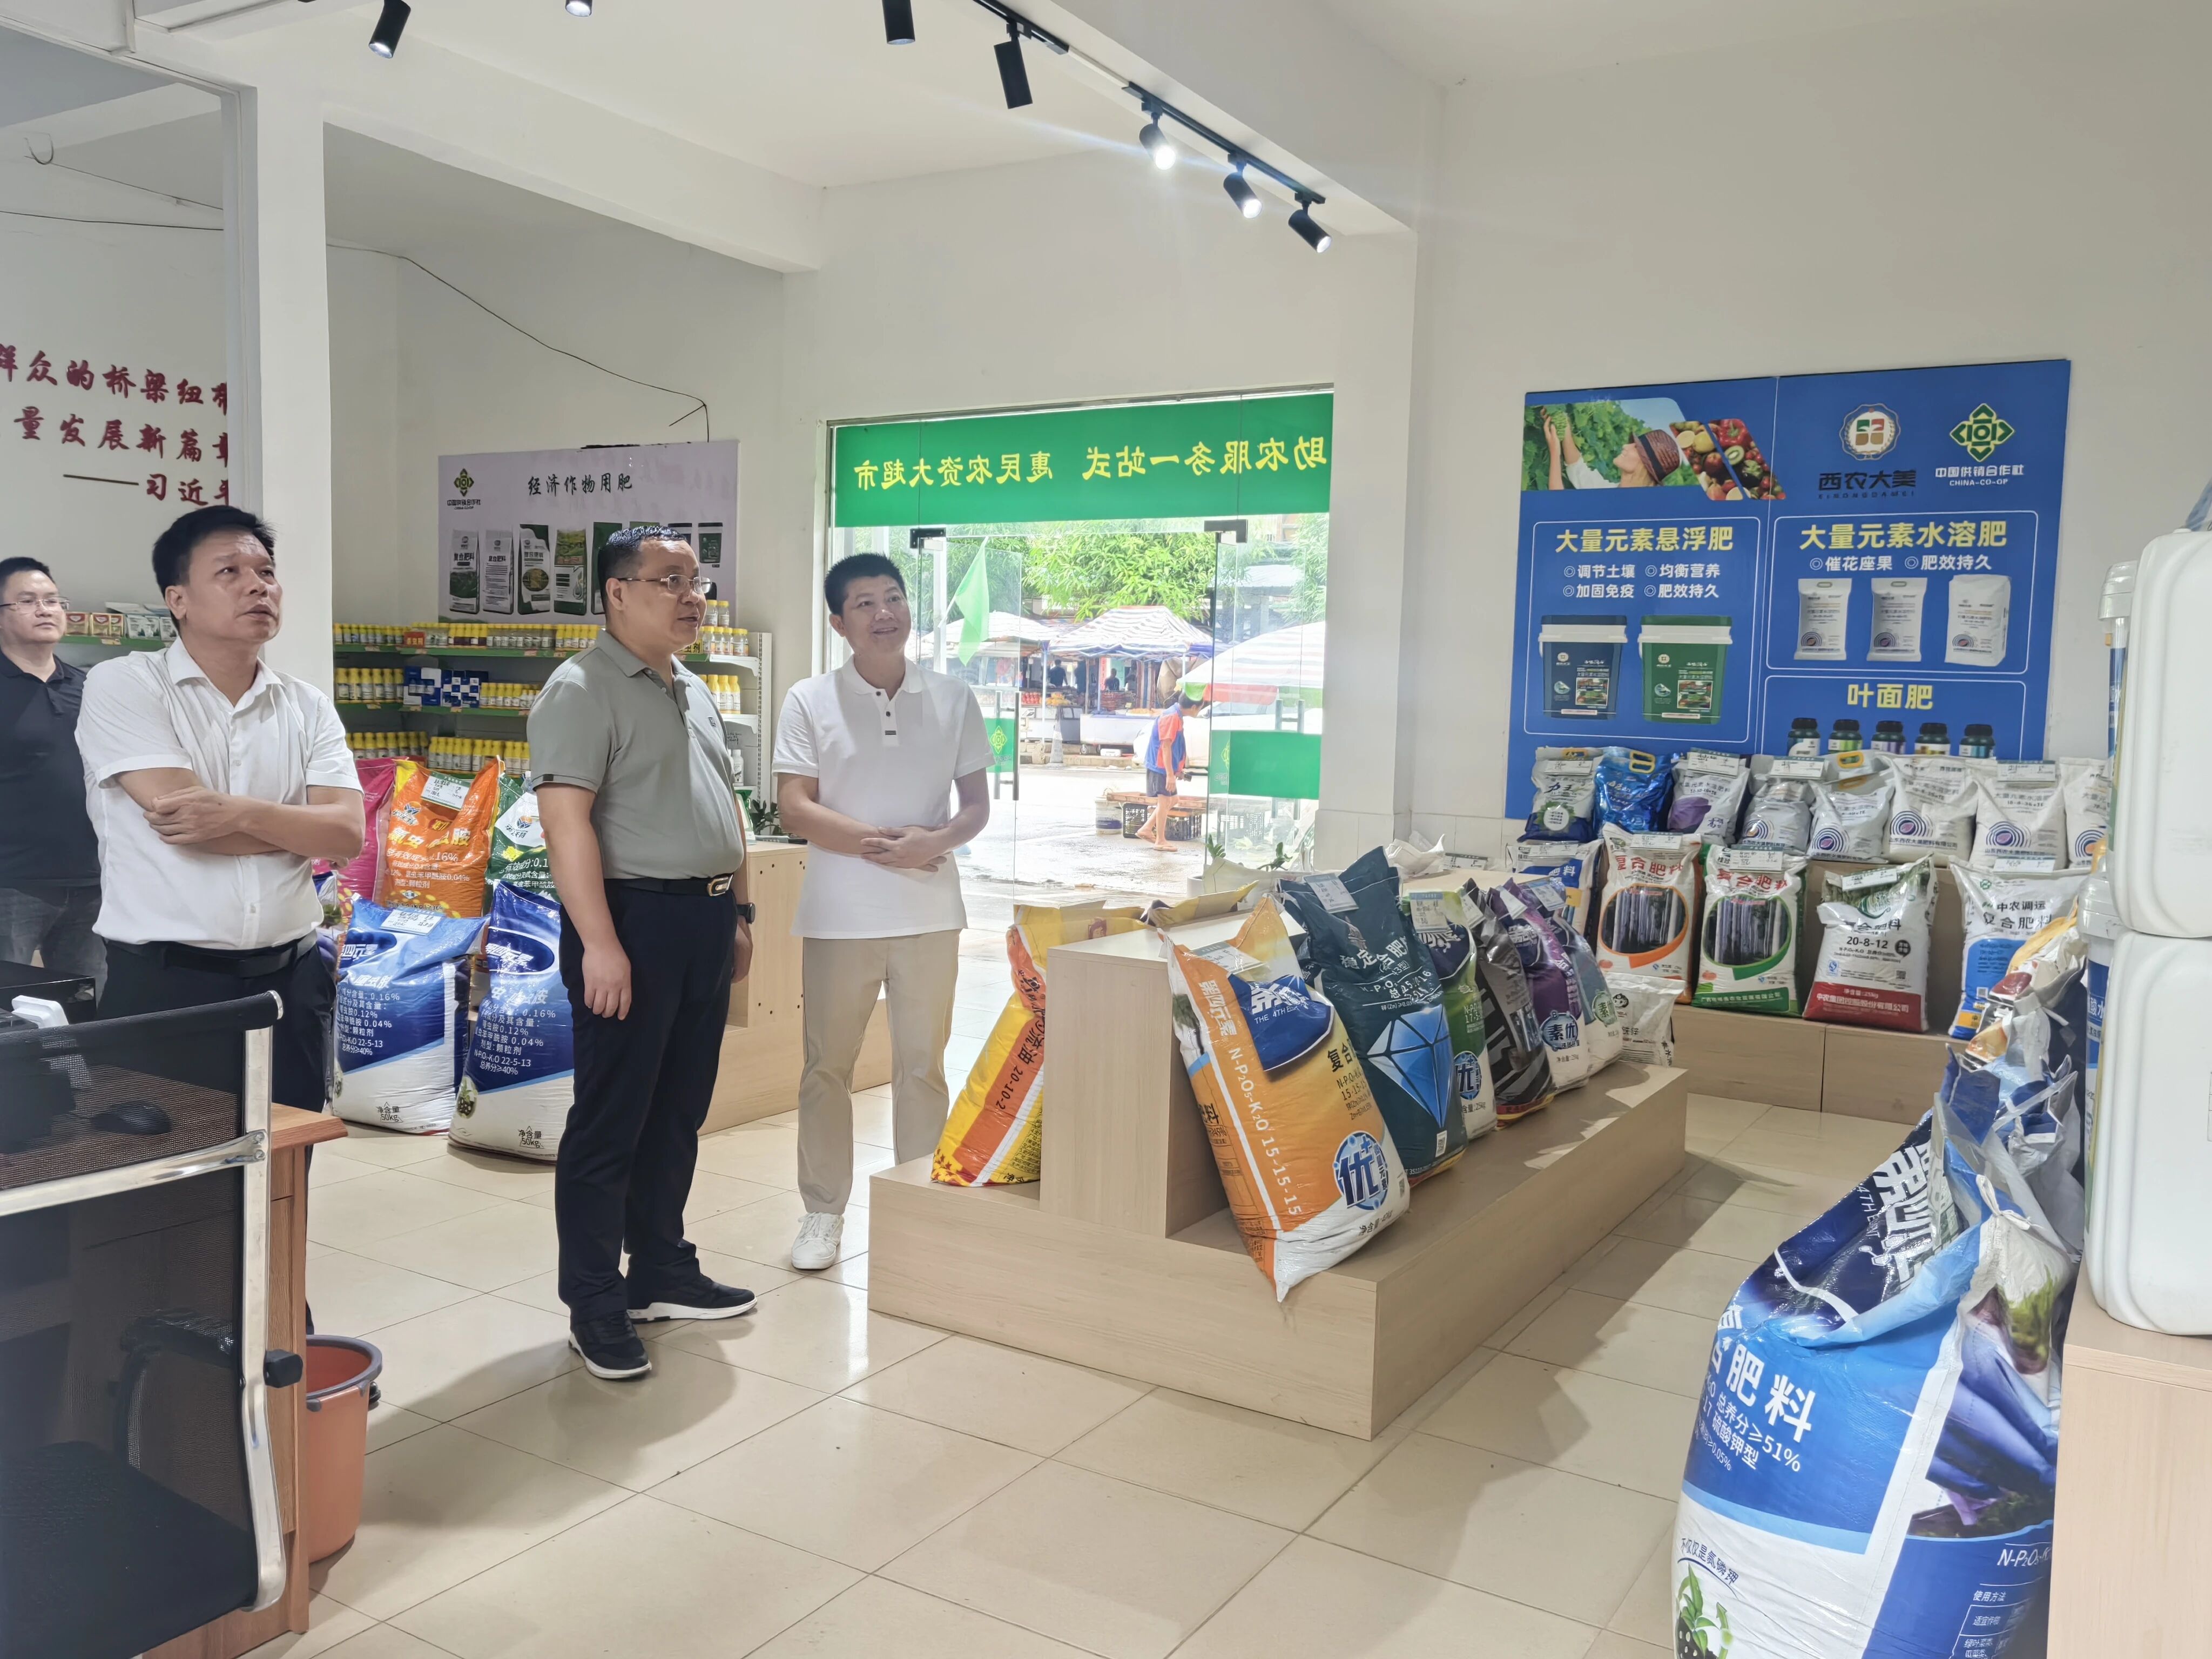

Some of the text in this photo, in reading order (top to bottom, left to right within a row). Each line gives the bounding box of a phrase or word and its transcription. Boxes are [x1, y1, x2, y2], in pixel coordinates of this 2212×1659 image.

[1935, 464, 2025, 478] 中国供销合作社
[528, 473, 633, 496] 经济作物用肥
[1949, 478, 2008, 487] CHINA-CO-OP
[1555, 526, 1734, 553] 大量元素悬浮肥
[1799, 521, 2007, 550] 大量元素水溶肥
[1825, 555, 1992, 571] 催花座果 肥效持久
[1578, 563, 1721, 578] 调节土壤 均衡营养
[1576, 584, 1719, 598] 加固免疫 肥效持久
[1847, 683, 1933, 710] 叶面肥
[1997, 901, 2046, 912] 中农调运
[1846, 936, 1889, 949] 20-8-12
[341, 943, 378, 962] 四元素
[1255, 1009, 1286, 1024] THE 4TH
[358, 1038, 383, 1048] 22-5-13
[511, 1036, 544, 1047] 0.04%
[501, 1057, 531, 1067] 22-5-13
[377, 1106, 400, 1114] 净含量
[380, 1113, 400, 1122] 50kg
[518, 1130, 542, 1139] 净含量
[521, 1138, 541, 1149] 50kg
[1261, 1135, 1303, 1216] 15-15-15
[1717, 1390, 1801, 1472] 总养分≥51%
[1712, 1411, 1759, 1470] 硫酸钾型
[1681, 1537, 1739, 1585] 不仅仅是氮磷钾
[1973, 1590, 2007, 1602] 使用方法
